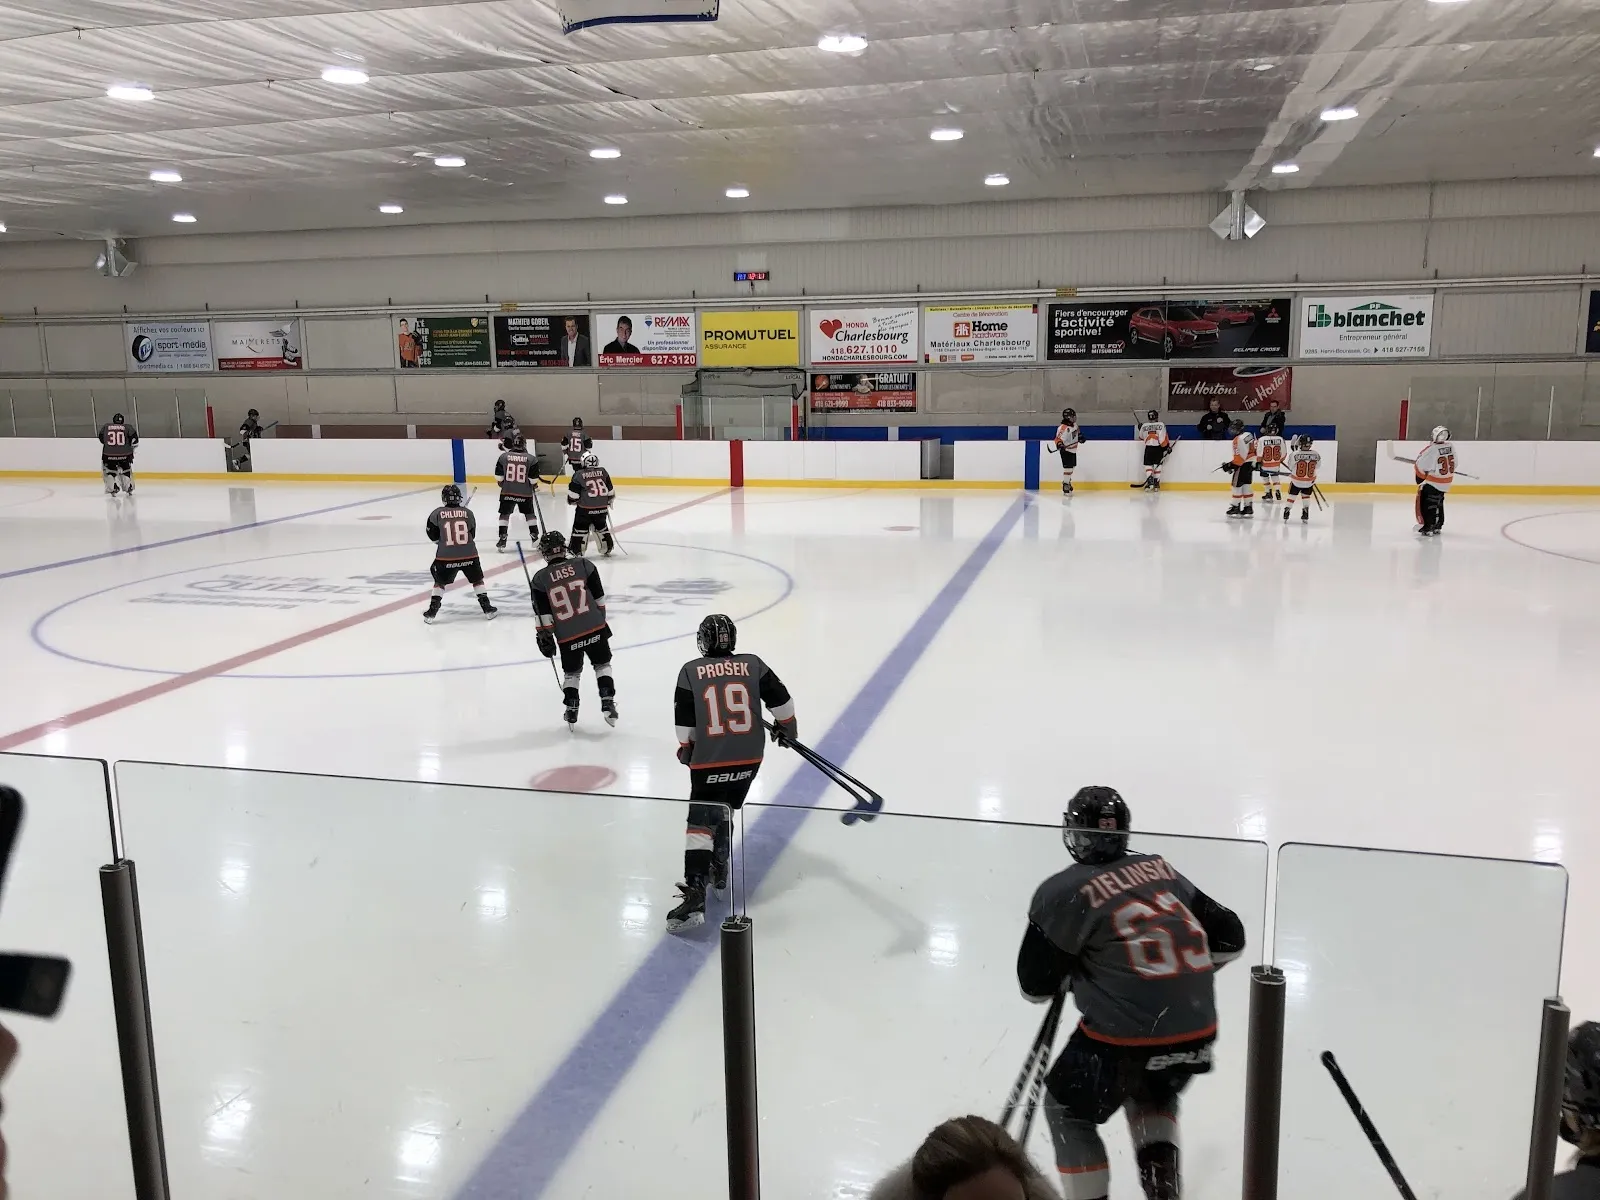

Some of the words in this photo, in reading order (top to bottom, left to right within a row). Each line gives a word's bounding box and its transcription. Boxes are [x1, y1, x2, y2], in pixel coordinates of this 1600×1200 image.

[1055, 309, 1075, 317] Fiers
[1077, 309, 1128, 318] d'encourager
[1334, 310, 1426, 327] blanchet
[508, 318, 530, 326] MATHIEU
[654, 316, 690, 328] RE/MAX
[972, 320, 1008, 332] Home
[1054, 316, 1115, 328] l'activité
[704, 329, 796, 341] PROMUTUEL
[835, 329, 909, 344] Charlesbourg
[972, 331, 1008, 339] hardware
[1054, 327, 1102, 338] sportive!
[1383, 333, 1408, 341] général
[930, 340, 970, 348] Matériaux
[973, 339, 1031, 347] Charlesbourg
[651, 355, 695, 364] 627-3120
[879, 373, 909, 384] GRATUIT
[1171, 381, 1191, 395] Tim
[1193, 380, 1237, 395] Hortons
[1242, 395, 1260, 410] Tim
[1255, 367, 1290, 401] Hortons
[107, 431, 126, 446] 30
[570, 438, 582, 452] 15
[505, 463, 527, 483] 88
[586, 479, 609, 498] 38
[443, 520, 469, 546] 18
[446, 560, 474, 569] BAUER
[549, 579, 590, 621] 97
[570, 634, 601, 651] BAUER
[703, 682, 753, 738] 19
[706, 769, 753, 784] BAUER
[1111, 889, 1216, 981] 63
